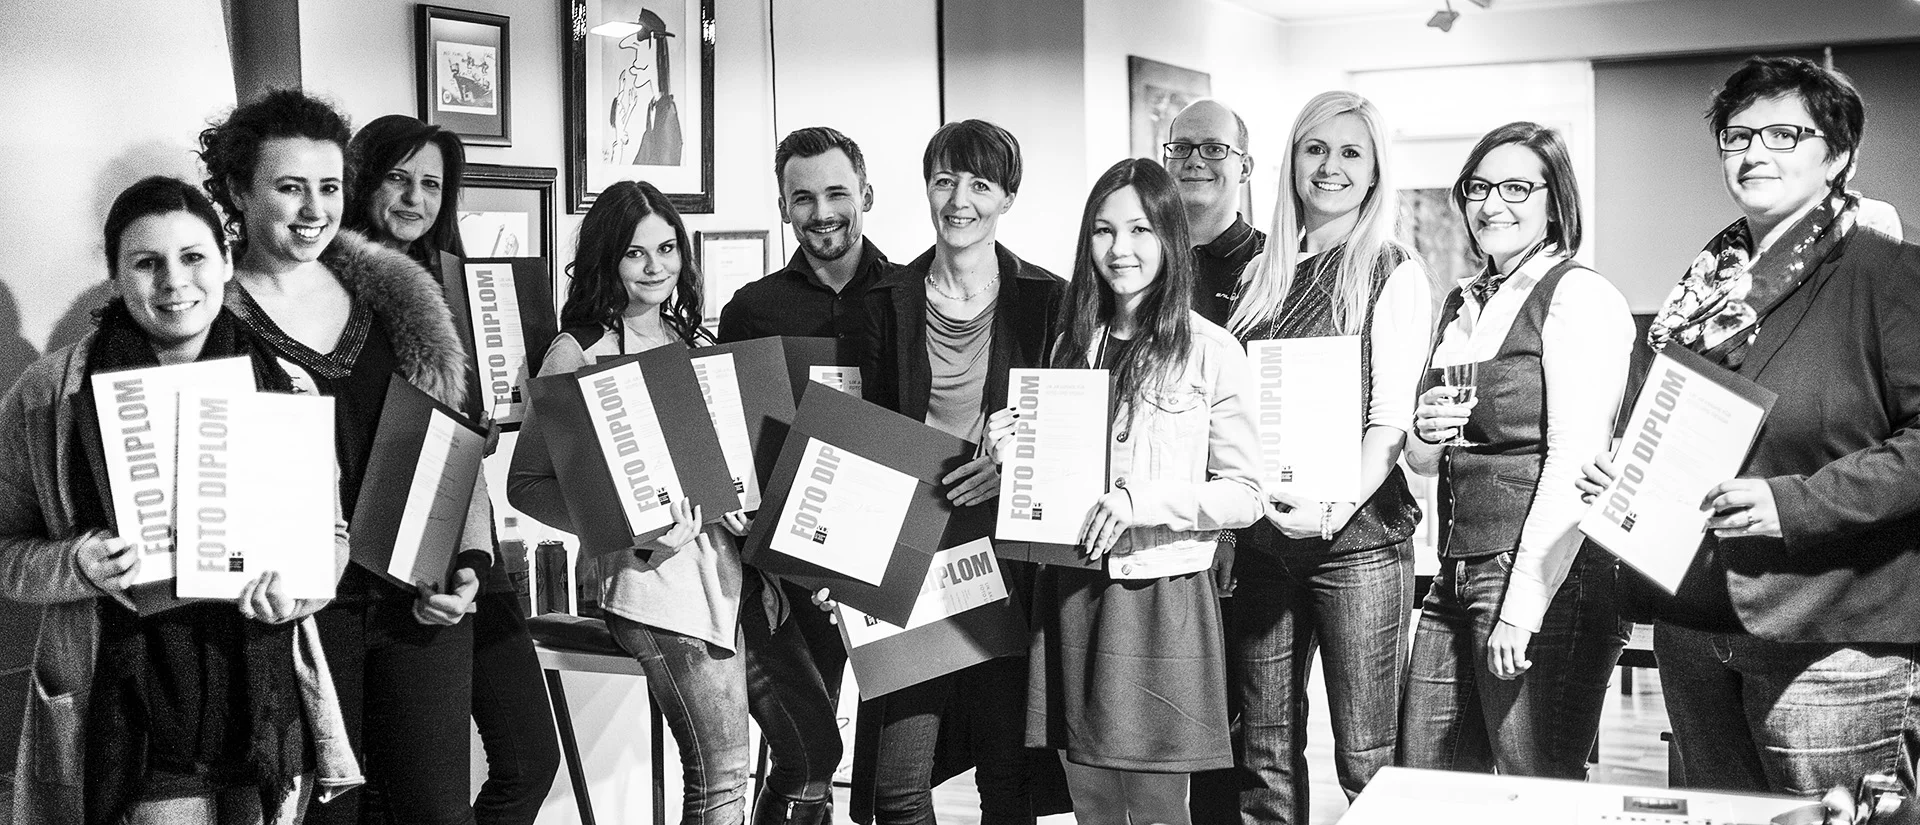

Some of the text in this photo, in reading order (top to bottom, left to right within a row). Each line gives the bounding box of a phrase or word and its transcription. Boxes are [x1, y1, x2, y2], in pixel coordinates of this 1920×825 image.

[476, 270, 511, 405] FOTO DIPLOM
[1260, 346, 1283, 425] DIPLOM
[113, 378, 174, 555] FOTO DIPLOM
[593, 376, 640, 457] DIPLOM
[1010, 375, 1040, 520] FOTO DIPLOM
[1601, 368, 1687, 525] FOTO DIPLOM
[197, 398, 229, 572] FOTO DIPLOM
[624, 459, 660, 513] FOTO
[790, 486, 828, 541] FOTO
